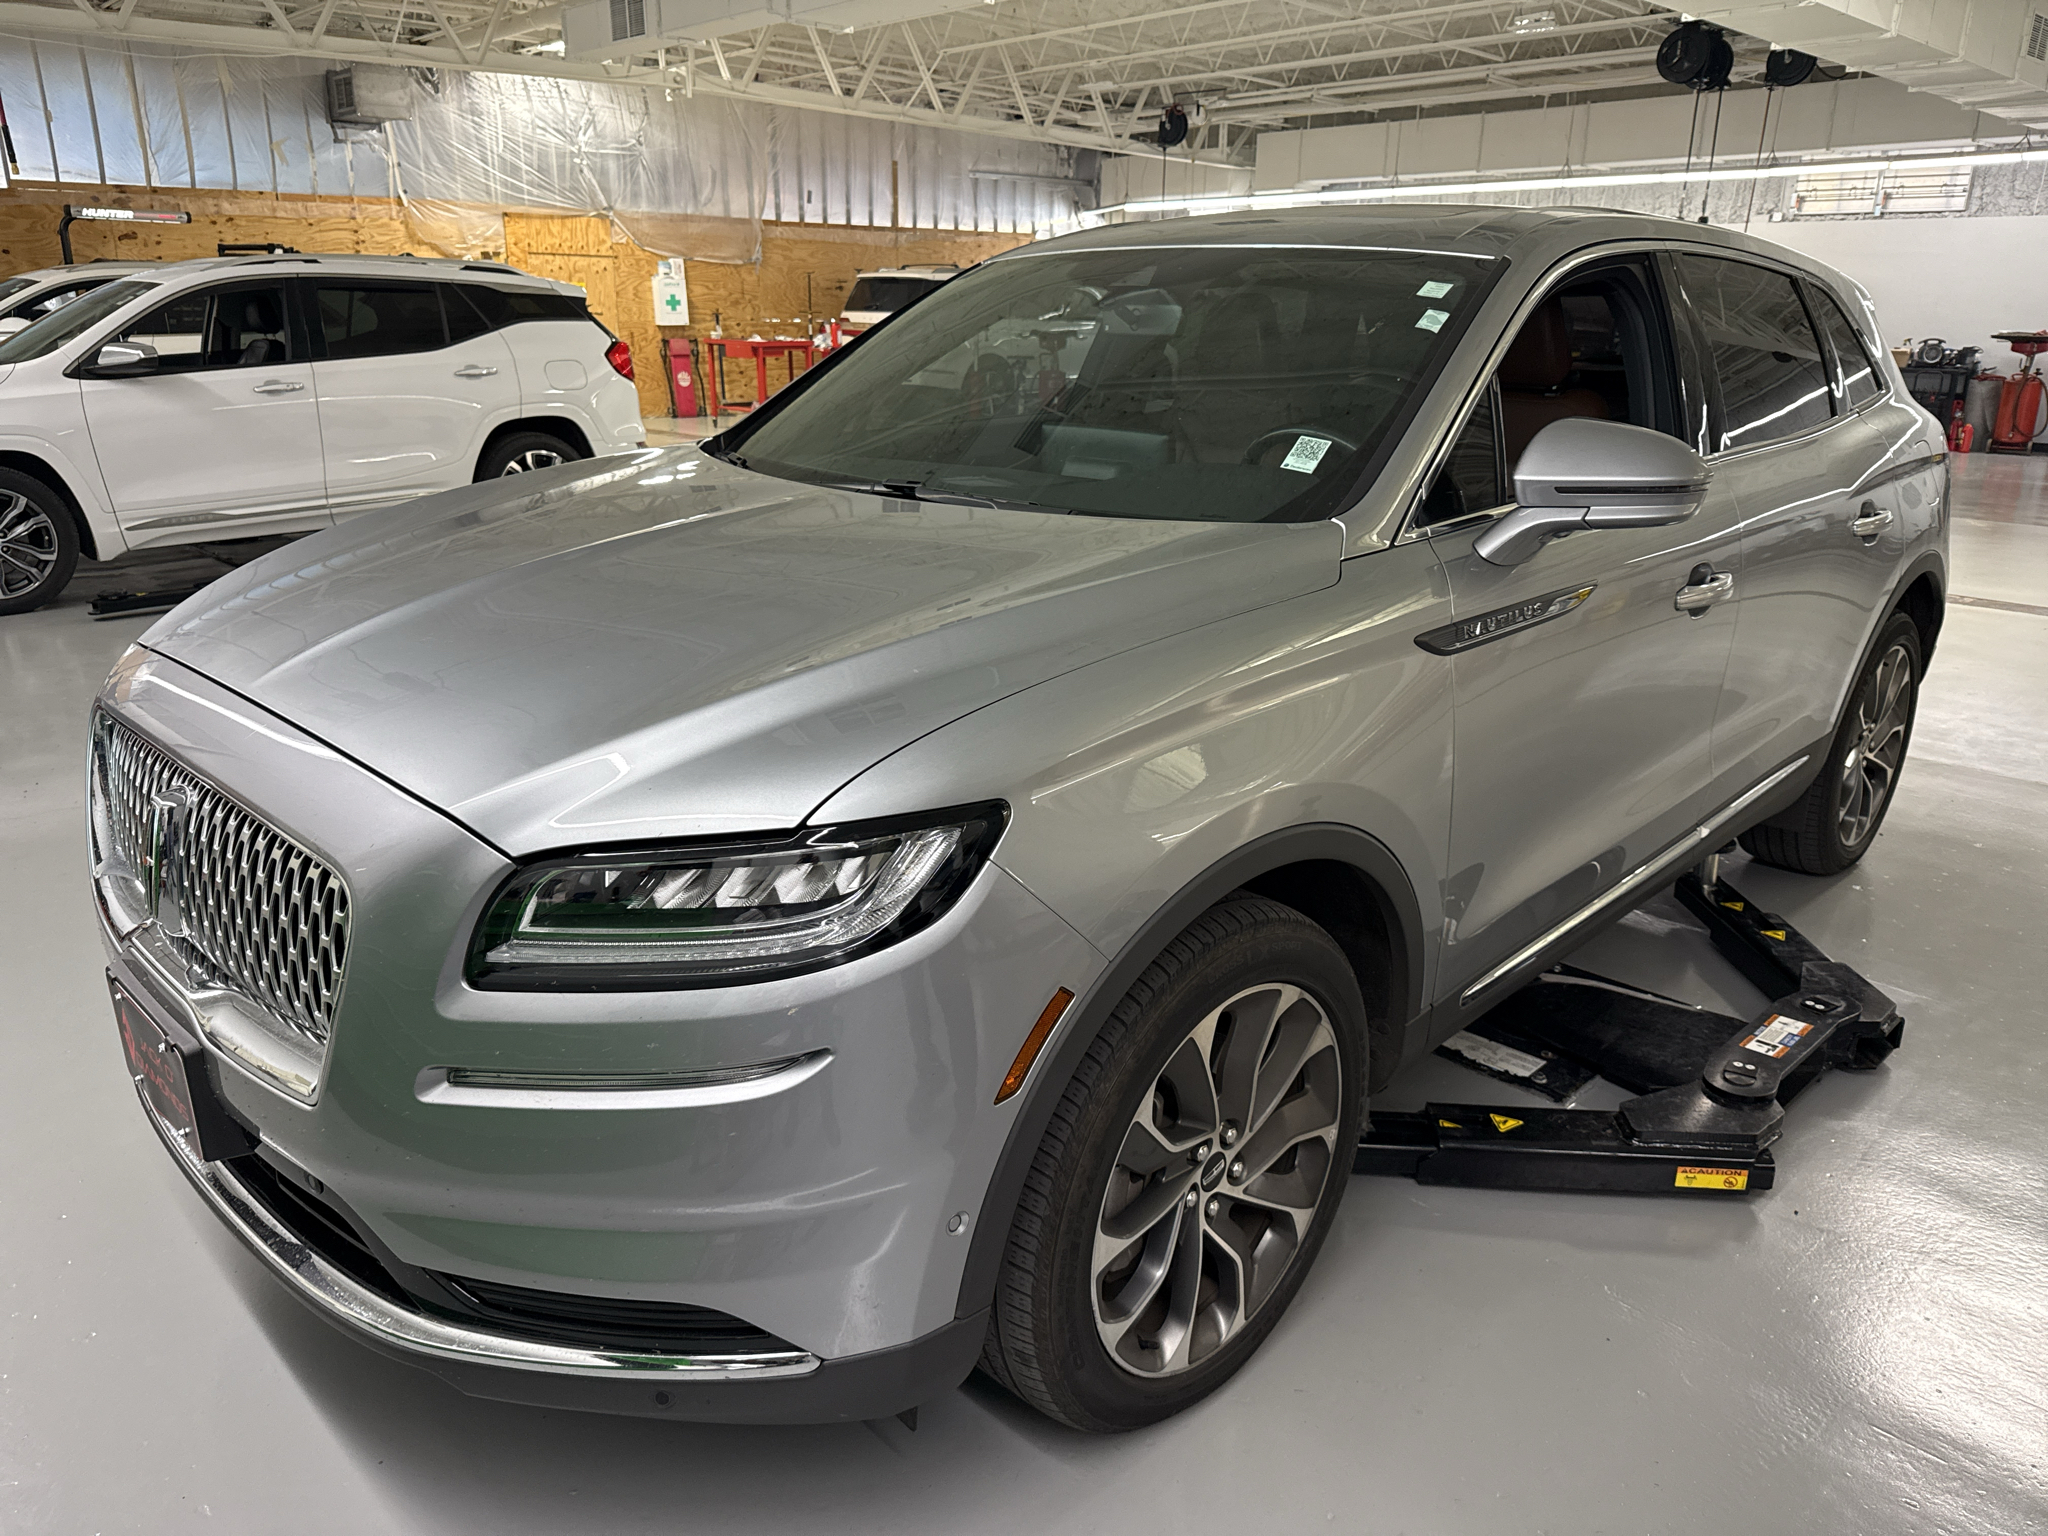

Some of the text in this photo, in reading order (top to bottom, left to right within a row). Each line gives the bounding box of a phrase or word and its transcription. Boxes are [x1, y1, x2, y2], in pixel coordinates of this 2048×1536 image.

[82, 207, 134, 219] HUNTER
[1463, 602, 1543, 639] NAUTILUS
[1688, 1168, 1742, 1177] CAUTION
